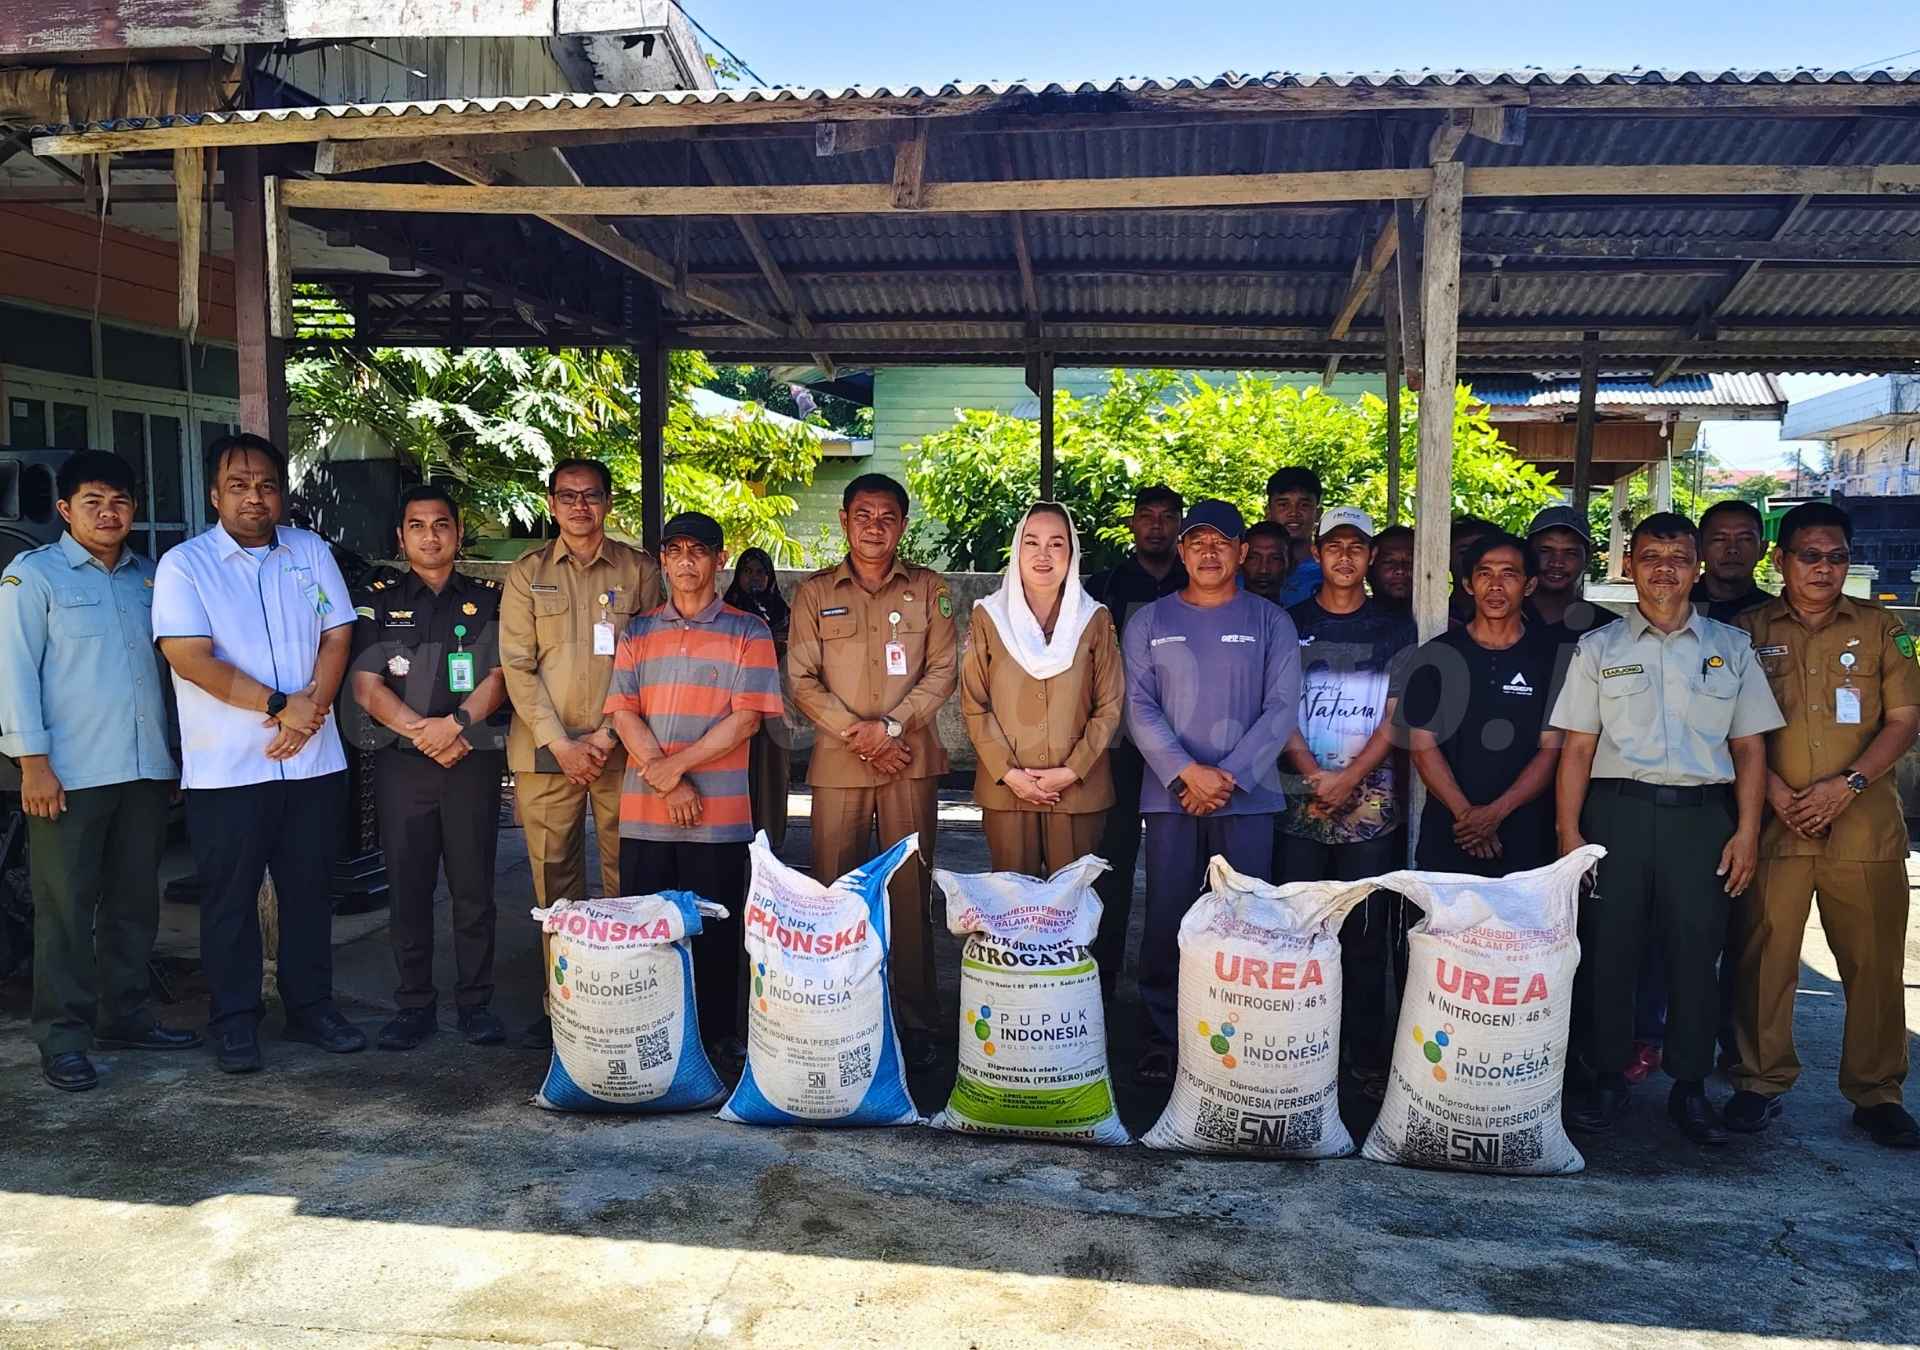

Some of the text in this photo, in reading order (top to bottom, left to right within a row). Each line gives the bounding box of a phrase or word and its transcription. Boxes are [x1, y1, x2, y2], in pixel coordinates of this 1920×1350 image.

[747, 904, 867, 955] PHONSKA
[788, 916, 817, 933] NPK
[1214, 950, 1324, 991] UREA
[1436, 957, 1549, 1006] UREA
[575, 977, 658, 998] INDONESIA
[769, 984, 852, 1006] INDONESIA
[1209, 986, 1217, 999] N
[1220, 988, 1295, 1012] (NITROGEN)
[1304, 997, 1317, 1008] 46
[1427, 991, 1436, 1006] N
[1438, 999, 1516, 1027] (NITROGEN)
[1526, 1010, 1540, 1023] 46
[1000, 1024, 1088, 1042] INDONESIA
[1243, 1040, 1330, 1063] INDONESIA
[979, 1069, 1031, 1085] INDONESIA
[1033, 1071, 1084, 1086] (PERSERO)
[1455, 1055, 1551, 1080] INDONESIA
[1188, 1074, 1216, 1097] PUPUK
[1216, 1088, 1273, 1111] INDONESIA
[1273, 1093, 1323, 1111] (PERSERO)
[1229, 1079, 1299, 1095] Diproduksi oleh
[1424, 1099, 1483, 1127] INDONESIA
[1484, 1107, 1539, 1129] (PERSERO)
[1438, 1092, 1512, 1112] Diproduksi oleh
[1240, 1111, 1288, 1147] SNI
[1451, 1129, 1499, 1166] SNI
